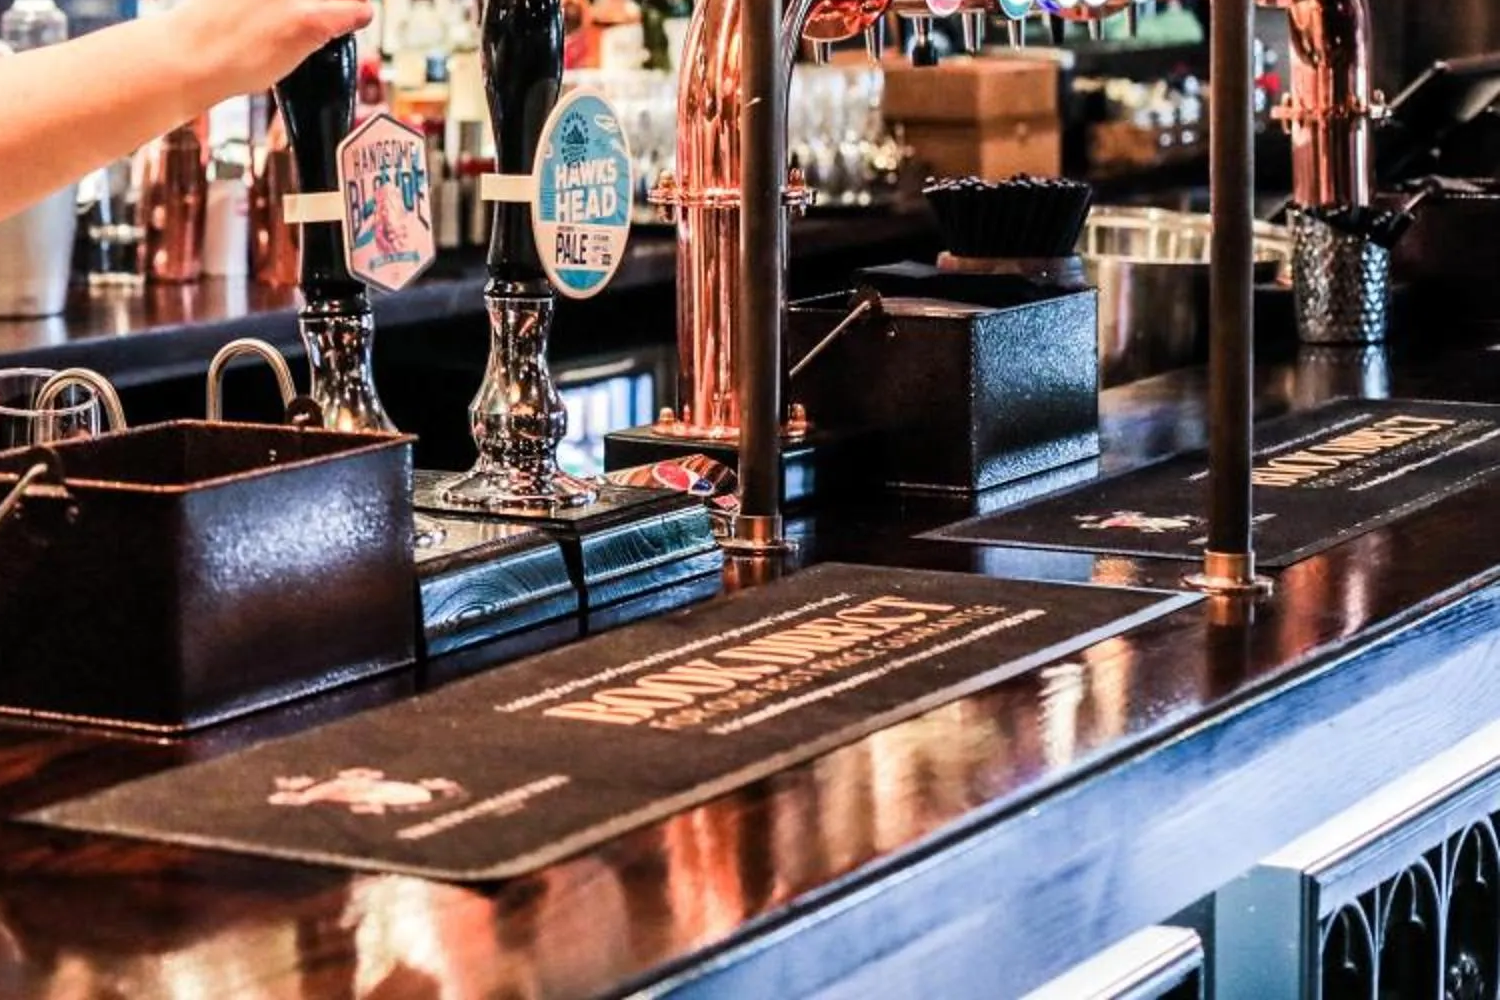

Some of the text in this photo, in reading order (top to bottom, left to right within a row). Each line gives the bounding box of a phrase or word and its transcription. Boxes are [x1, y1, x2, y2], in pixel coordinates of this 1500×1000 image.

[555, 158, 617, 190] HAWKS
[555, 185, 618, 223] HEAD
[555, 231, 588, 265] PALE
[541, 659, 782, 726] BOOK
[714, 595, 956, 665] DIRECT
